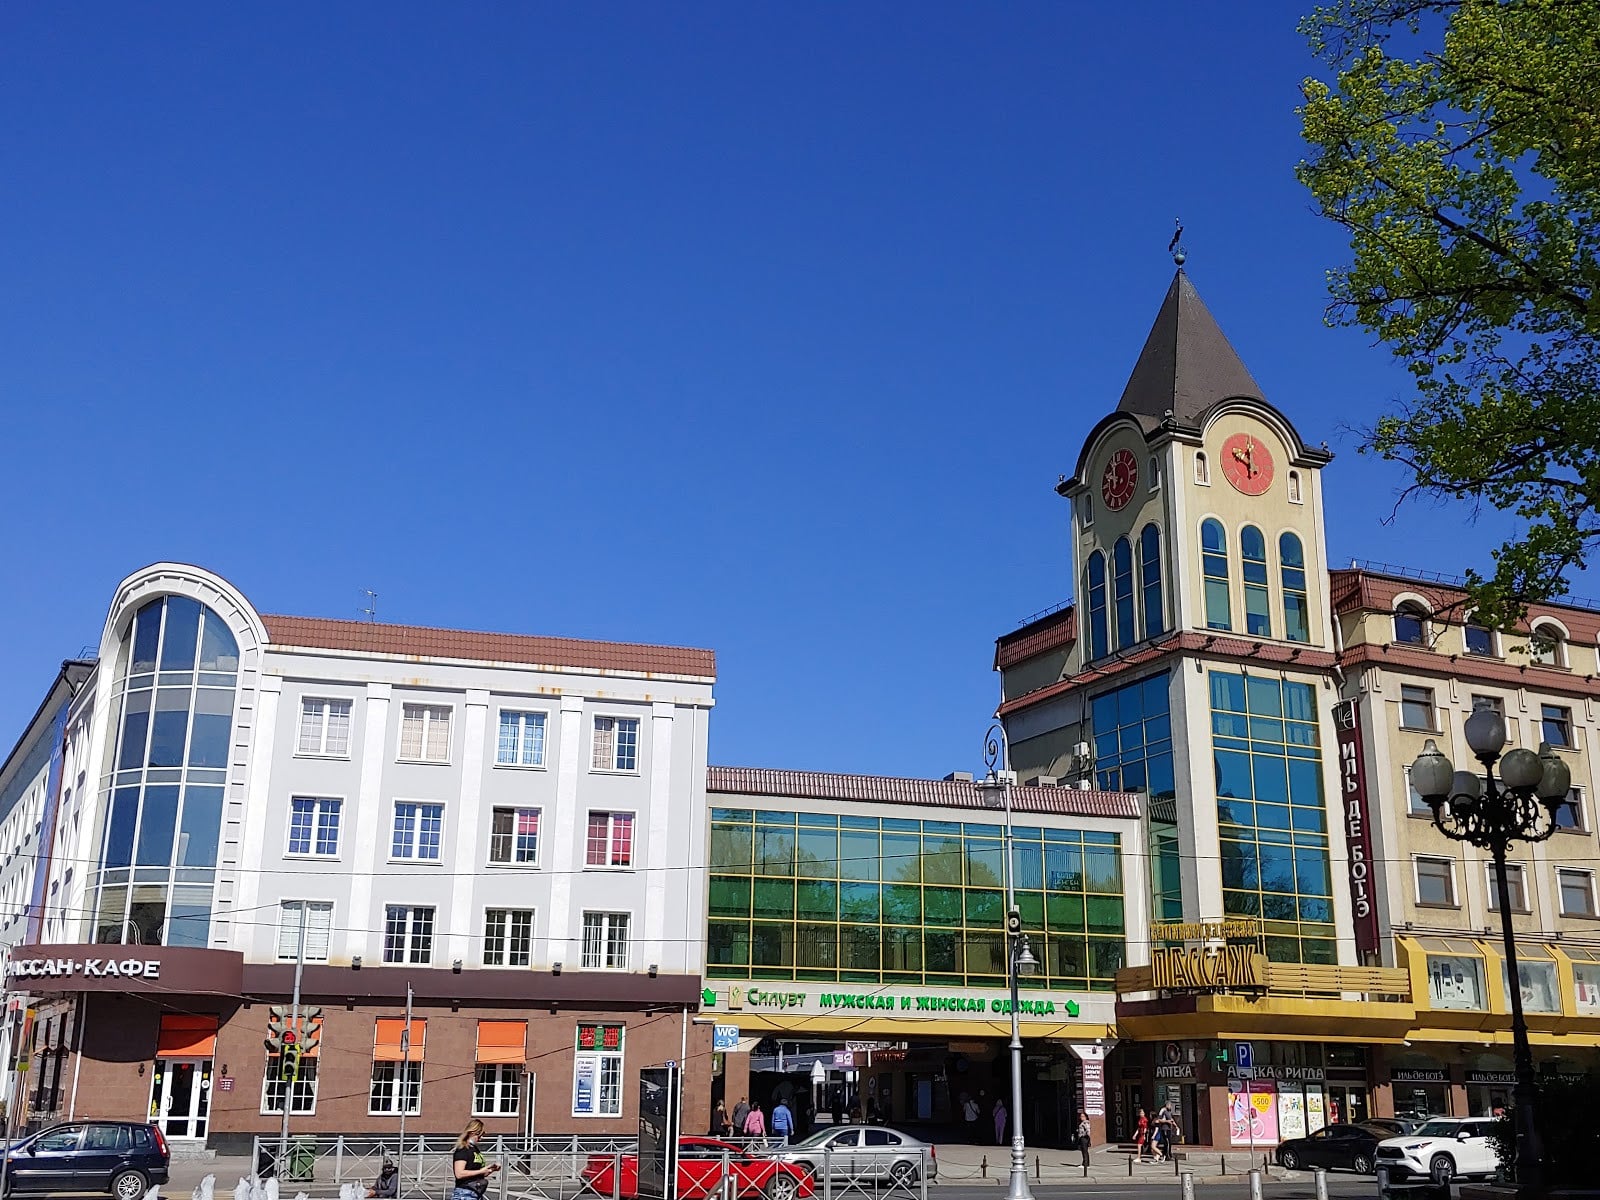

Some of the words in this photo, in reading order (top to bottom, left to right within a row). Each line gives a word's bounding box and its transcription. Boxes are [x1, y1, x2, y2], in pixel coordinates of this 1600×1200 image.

[1341, 741, 1358, 793] ИЛЬ
[1348, 799, 1361, 838] ДЕ
[1351, 845, 1370, 918] БОТЭ
[1151, 944, 1257, 987] ПАССАЖ
[820, 993, 895, 1011] МУЖСКАЯ
[900, 996, 912, 1011] И
[916, 996, 986, 1013] ЖЕНСКАЯ
[991, 998, 1055, 1016] ОДЖДА
[716, 1027, 737, 1038] WC
[1156, 1065, 1193, 1078] АПТЕКА
